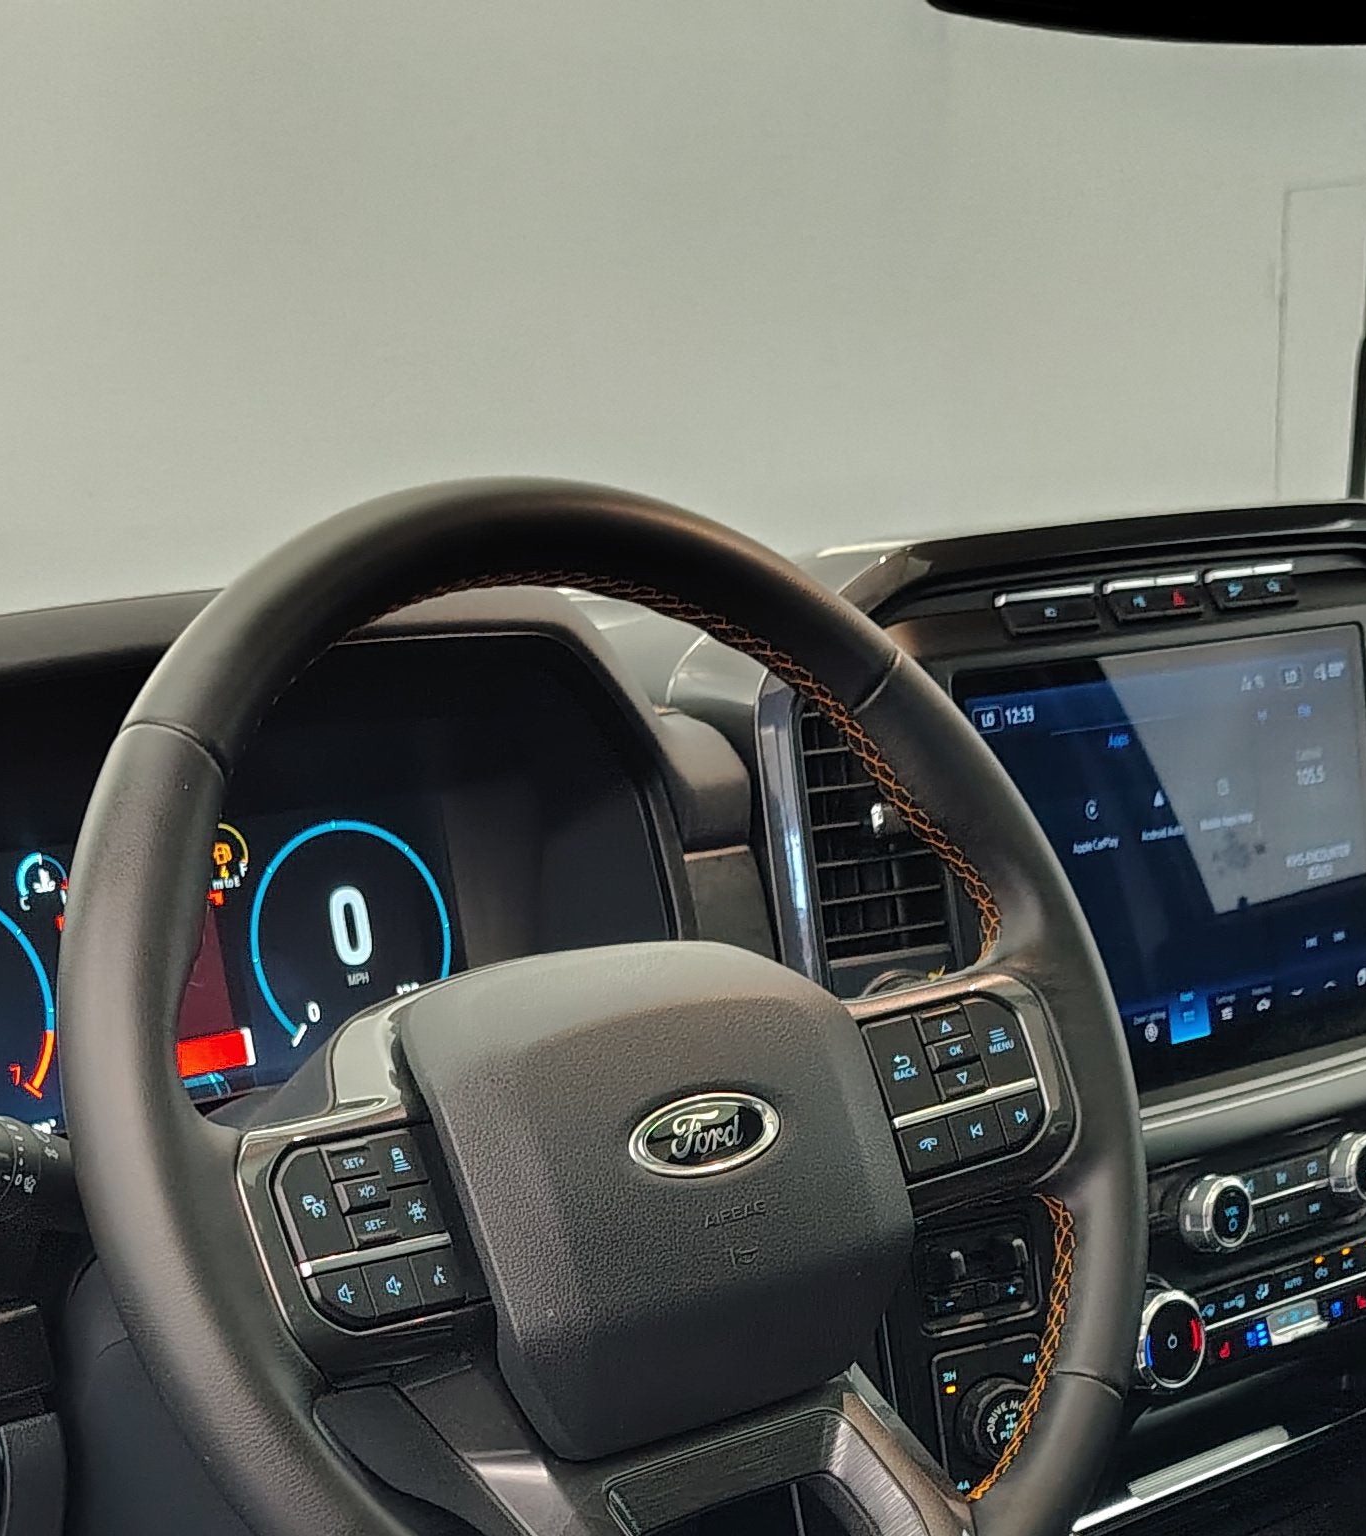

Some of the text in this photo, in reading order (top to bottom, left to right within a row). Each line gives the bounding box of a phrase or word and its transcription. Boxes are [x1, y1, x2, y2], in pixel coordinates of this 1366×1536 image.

[1004, 705, 1035, 725] 12:33
[329, 885, 373, 966] 0
[346, 972, 371, 988] MPH
[947, 1043, 964, 1056] OK
[987, 1038, 1016, 1054] MENU
[892, 1066, 919, 1082] BACK
[670, 1109, 744, 1160] Ford
[341, 1156, 366, 1171] SET+
[1283, 1276, 1304, 1290] AUTO
[1022, 1353, 1036, 1364] 4H
[942, 1370, 957, 1383] 2H
[986, 1401, 1009, 1433] DRIVE
[956, 1480, 970, 1491] 4A
